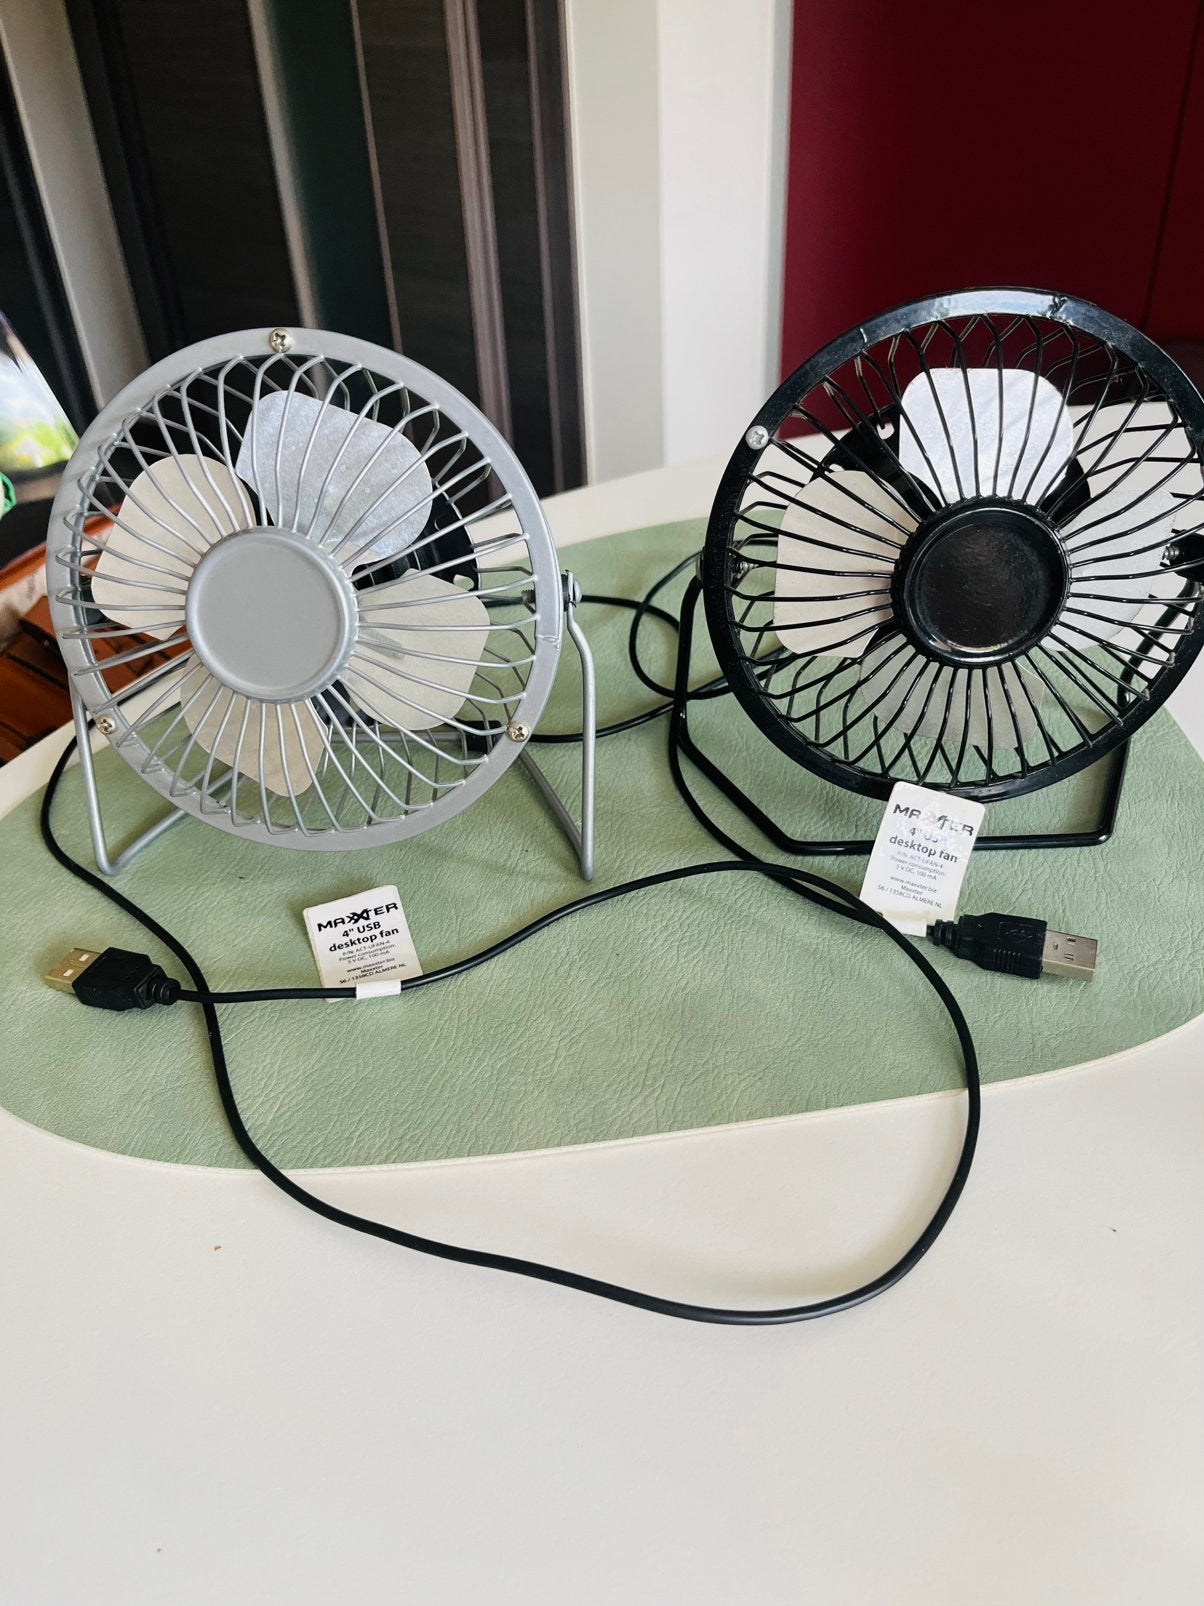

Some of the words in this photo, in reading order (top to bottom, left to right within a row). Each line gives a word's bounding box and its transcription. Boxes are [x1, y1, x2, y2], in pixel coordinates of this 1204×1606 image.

[889, 835, 936, 857] desktop
[939, 850, 958, 863] fan
[916, 870, 926, 878] 100
[927, 873, 937, 881] mA
[342, 928, 354, 938] 4"
[357, 921, 381, 934] USB
[329, 933, 377, 952] desktop
[379, 928, 399, 939] fan
